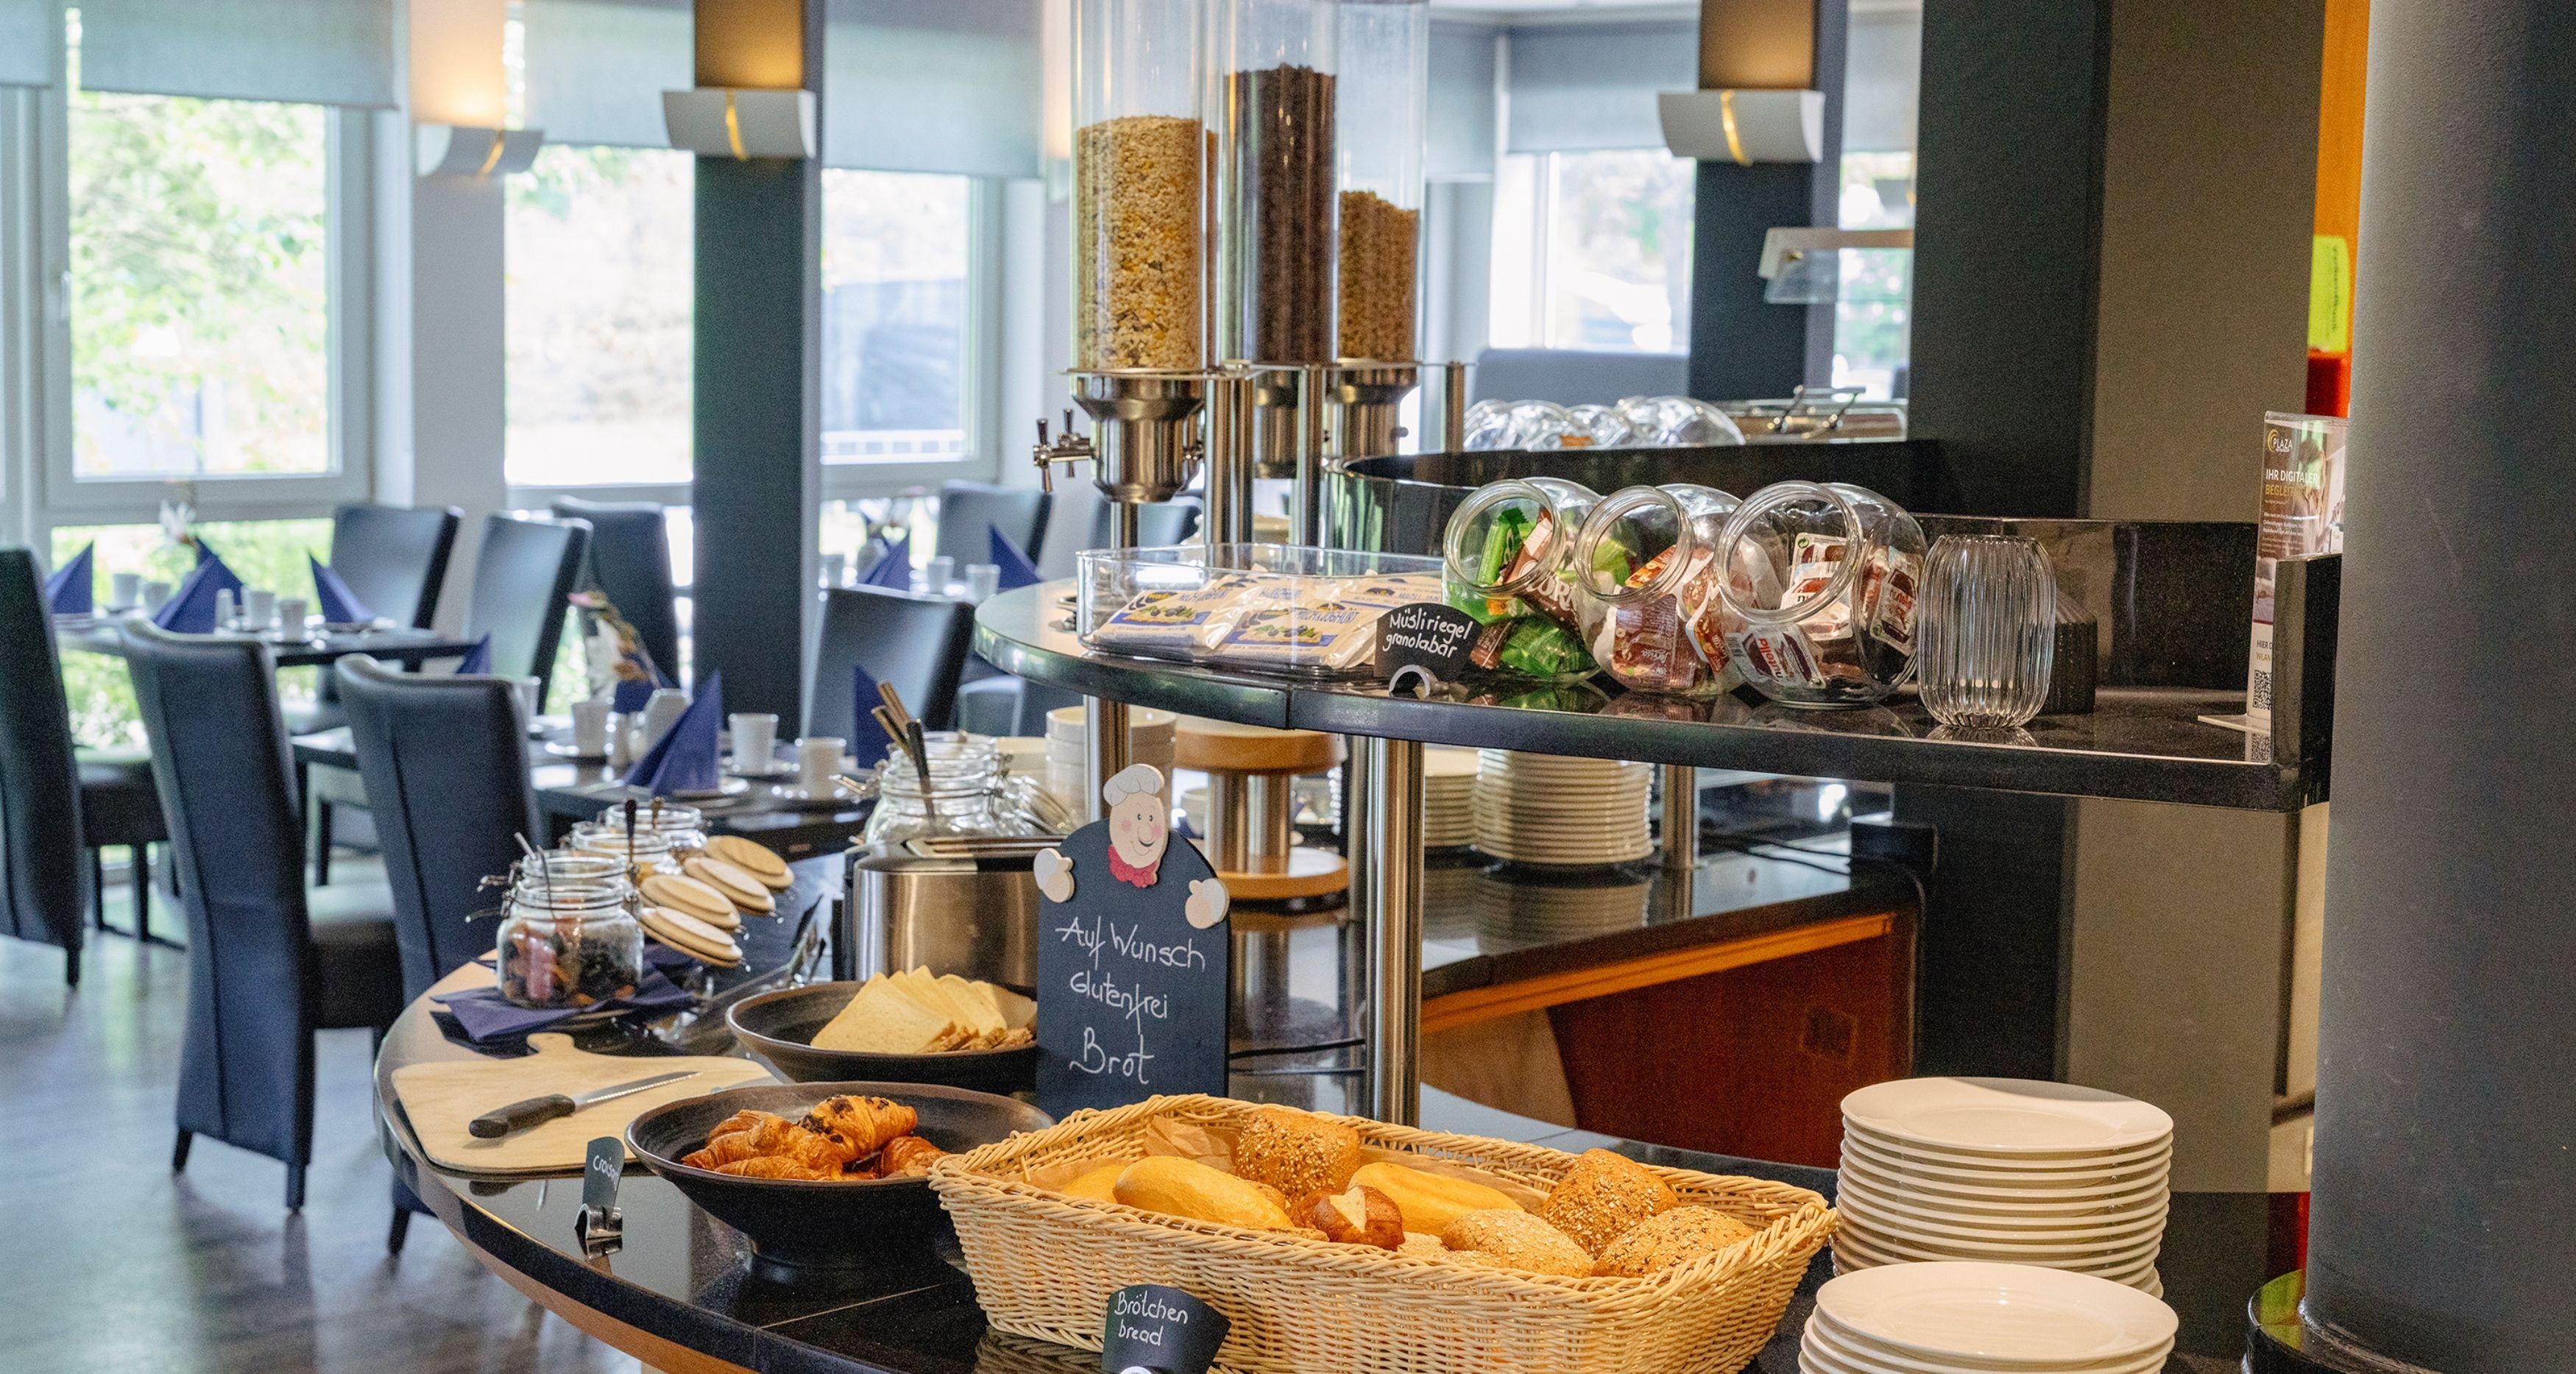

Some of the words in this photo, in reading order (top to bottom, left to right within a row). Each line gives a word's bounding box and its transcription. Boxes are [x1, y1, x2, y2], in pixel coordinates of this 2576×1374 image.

[2272, 438, 2293, 450] PLAZA
[2265, 469, 2279, 481] IHR
[2280, 470, 2318, 484] DIGITALER
[1389, 607, 1473, 645] Müsliriegel
[1381, 632, 1458, 659] granolabar
[1758, 637, 1784, 679] nutella
[1055, 916, 1106, 971] Auf
[1109, 921, 1206, 972] Wunsch
[1069, 1027, 1155, 1085] Brot
[1114, 1289, 1189, 1325] Brötchen
[1118, 1318, 1164, 1347] bread
